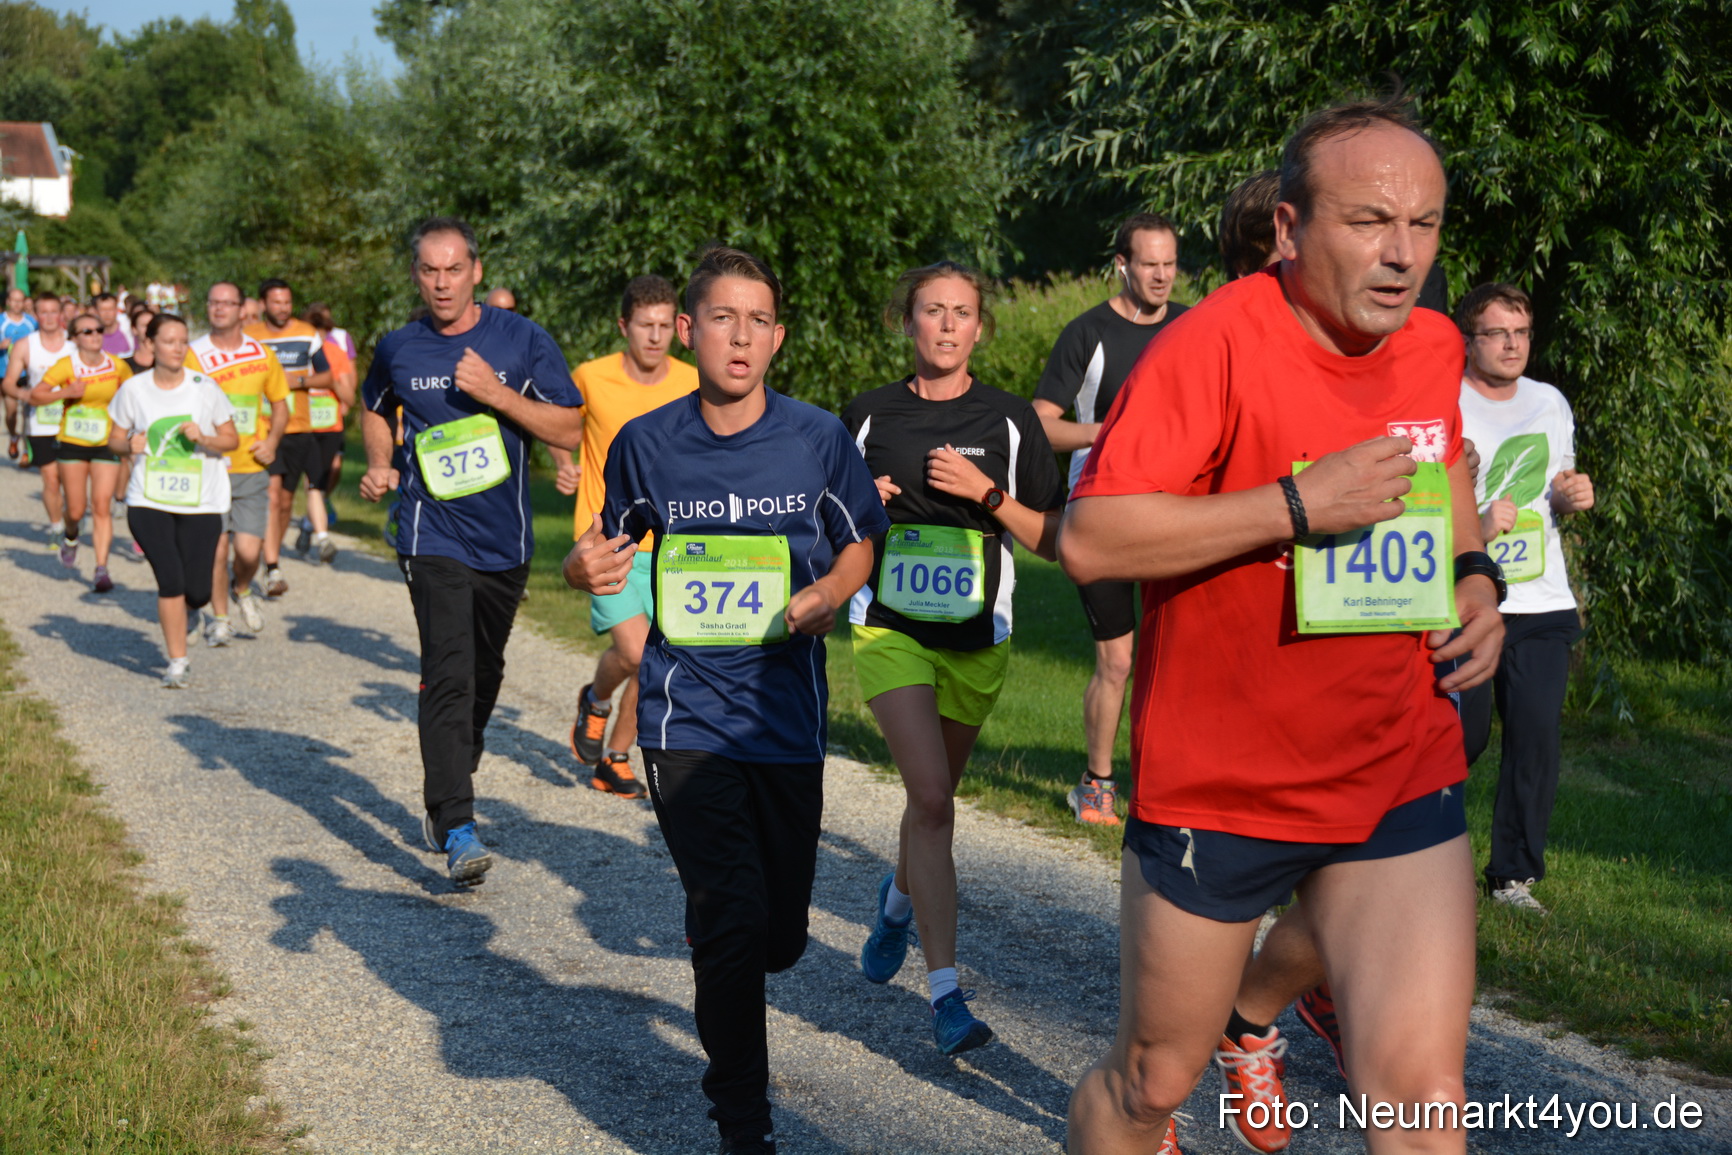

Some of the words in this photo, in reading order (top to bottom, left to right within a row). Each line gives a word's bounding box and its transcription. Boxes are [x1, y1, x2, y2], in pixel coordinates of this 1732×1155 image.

[411, 376, 452, 391] EURO
[438, 446, 490, 478] 373
[158, 475, 190, 492] 128
[668, 500, 725, 519] EURO
[747, 493, 807, 517] POLES
[677, 554, 723, 563] firmenlauf
[1315, 530, 1437, 584] 1403
[890, 561, 975, 598] 1066
[684, 580, 763, 615] 374
[925, 601, 951, 609] Meckler
[1343, 597, 1363, 607] Karl
[1365, 596, 1413, 608] Behninger
[700, 622, 724, 630] Sasha
[725, 622, 747, 630] Gradl
